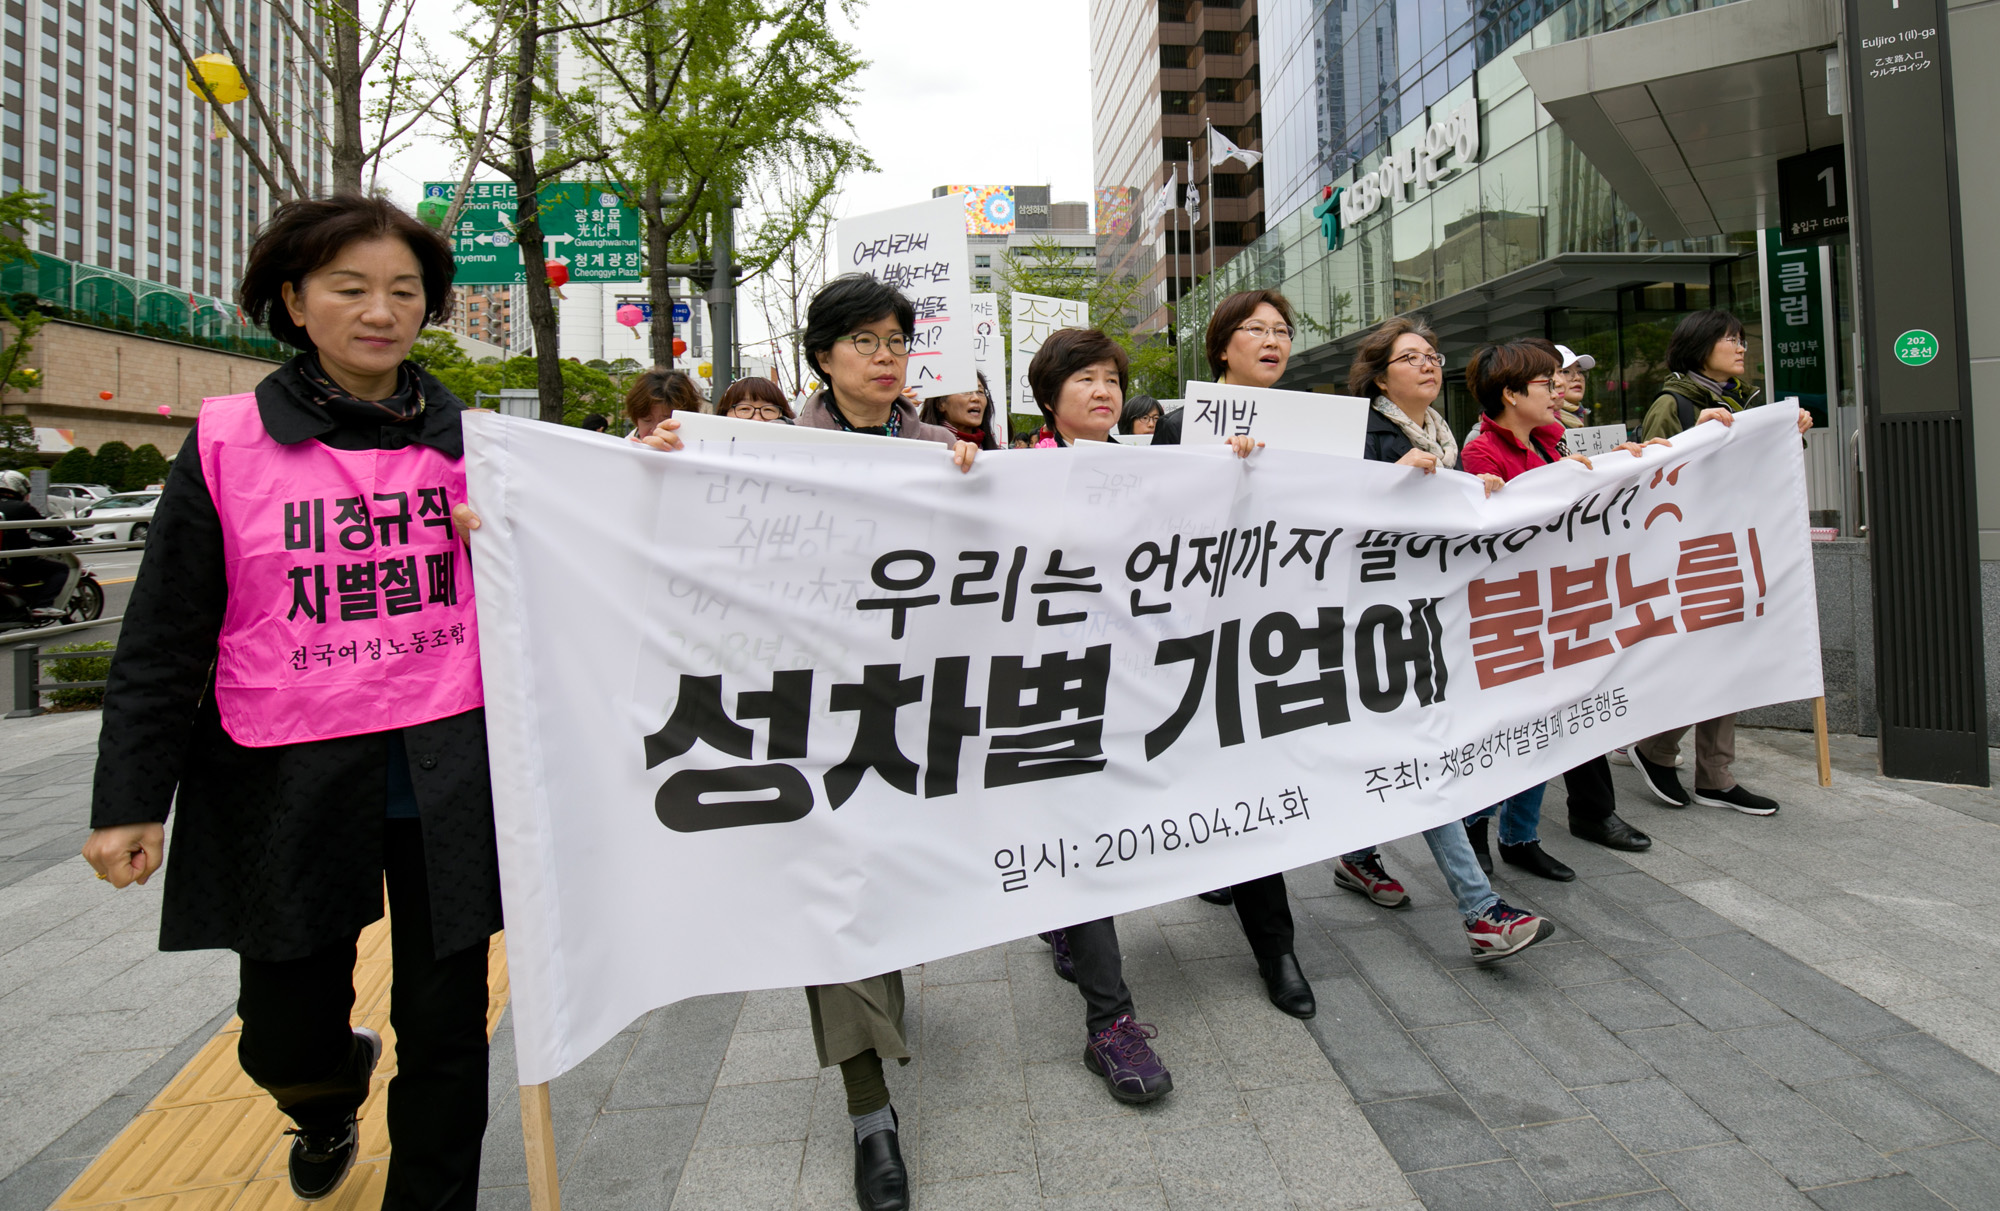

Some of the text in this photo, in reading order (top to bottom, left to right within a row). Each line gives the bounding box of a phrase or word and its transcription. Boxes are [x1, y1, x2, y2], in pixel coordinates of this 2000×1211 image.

[1862, 28, 1936, 49] Euljiro 1(il)-ga
[1875, 51, 1924, 67] 乙支路入口
[1817, 166, 1836, 208] 1
[492, 200, 518, 210] Rota
[602, 194, 618, 206] 50
[574, 208, 622, 223] 광화문
[1018, 204, 1048, 215] 삼성화재
[577, 223, 621, 238] 光化門
[1791, 215, 1849, 235] 출입구 Entra
[494, 234, 508, 245] 60
[574, 238, 638, 248] Gwanghwamun
[853, 233, 929, 265] 여자라서
[453, 254, 497, 265] nyemun
[574, 252, 639, 268] 청계광장
[574, 267, 639, 279] Cheonggye Plaza
[1777, 248, 1809, 326] 클럽
[971, 301, 993, 316] 자는
[1017, 297, 1079, 328] 조선
[1777, 340, 1819, 354] 영업1부
[1907, 336, 1926, 345] 202
[1901, 346, 1932, 358] 2호선
[1780, 356, 1817, 368] PB센터
[1194, 399, 1258, 437] 제발
[284, 486, 454, 553] 비정규직
[286, 551, 458, 624] 차별철폐
[855, 545, 1102, 640] 우리는
[1125, 520, 1344, 617] 언제까지
[288, 622, 467, 671] 전국여성노동조합
[643, 527, 1767, 833] 성차별 기업에 불분노를!
[1365, 686, 1629, 803] 주최: 채용성차별철폐 공동행동
[994, 785, 1311, 893] 일시: 2018.04.24.화
